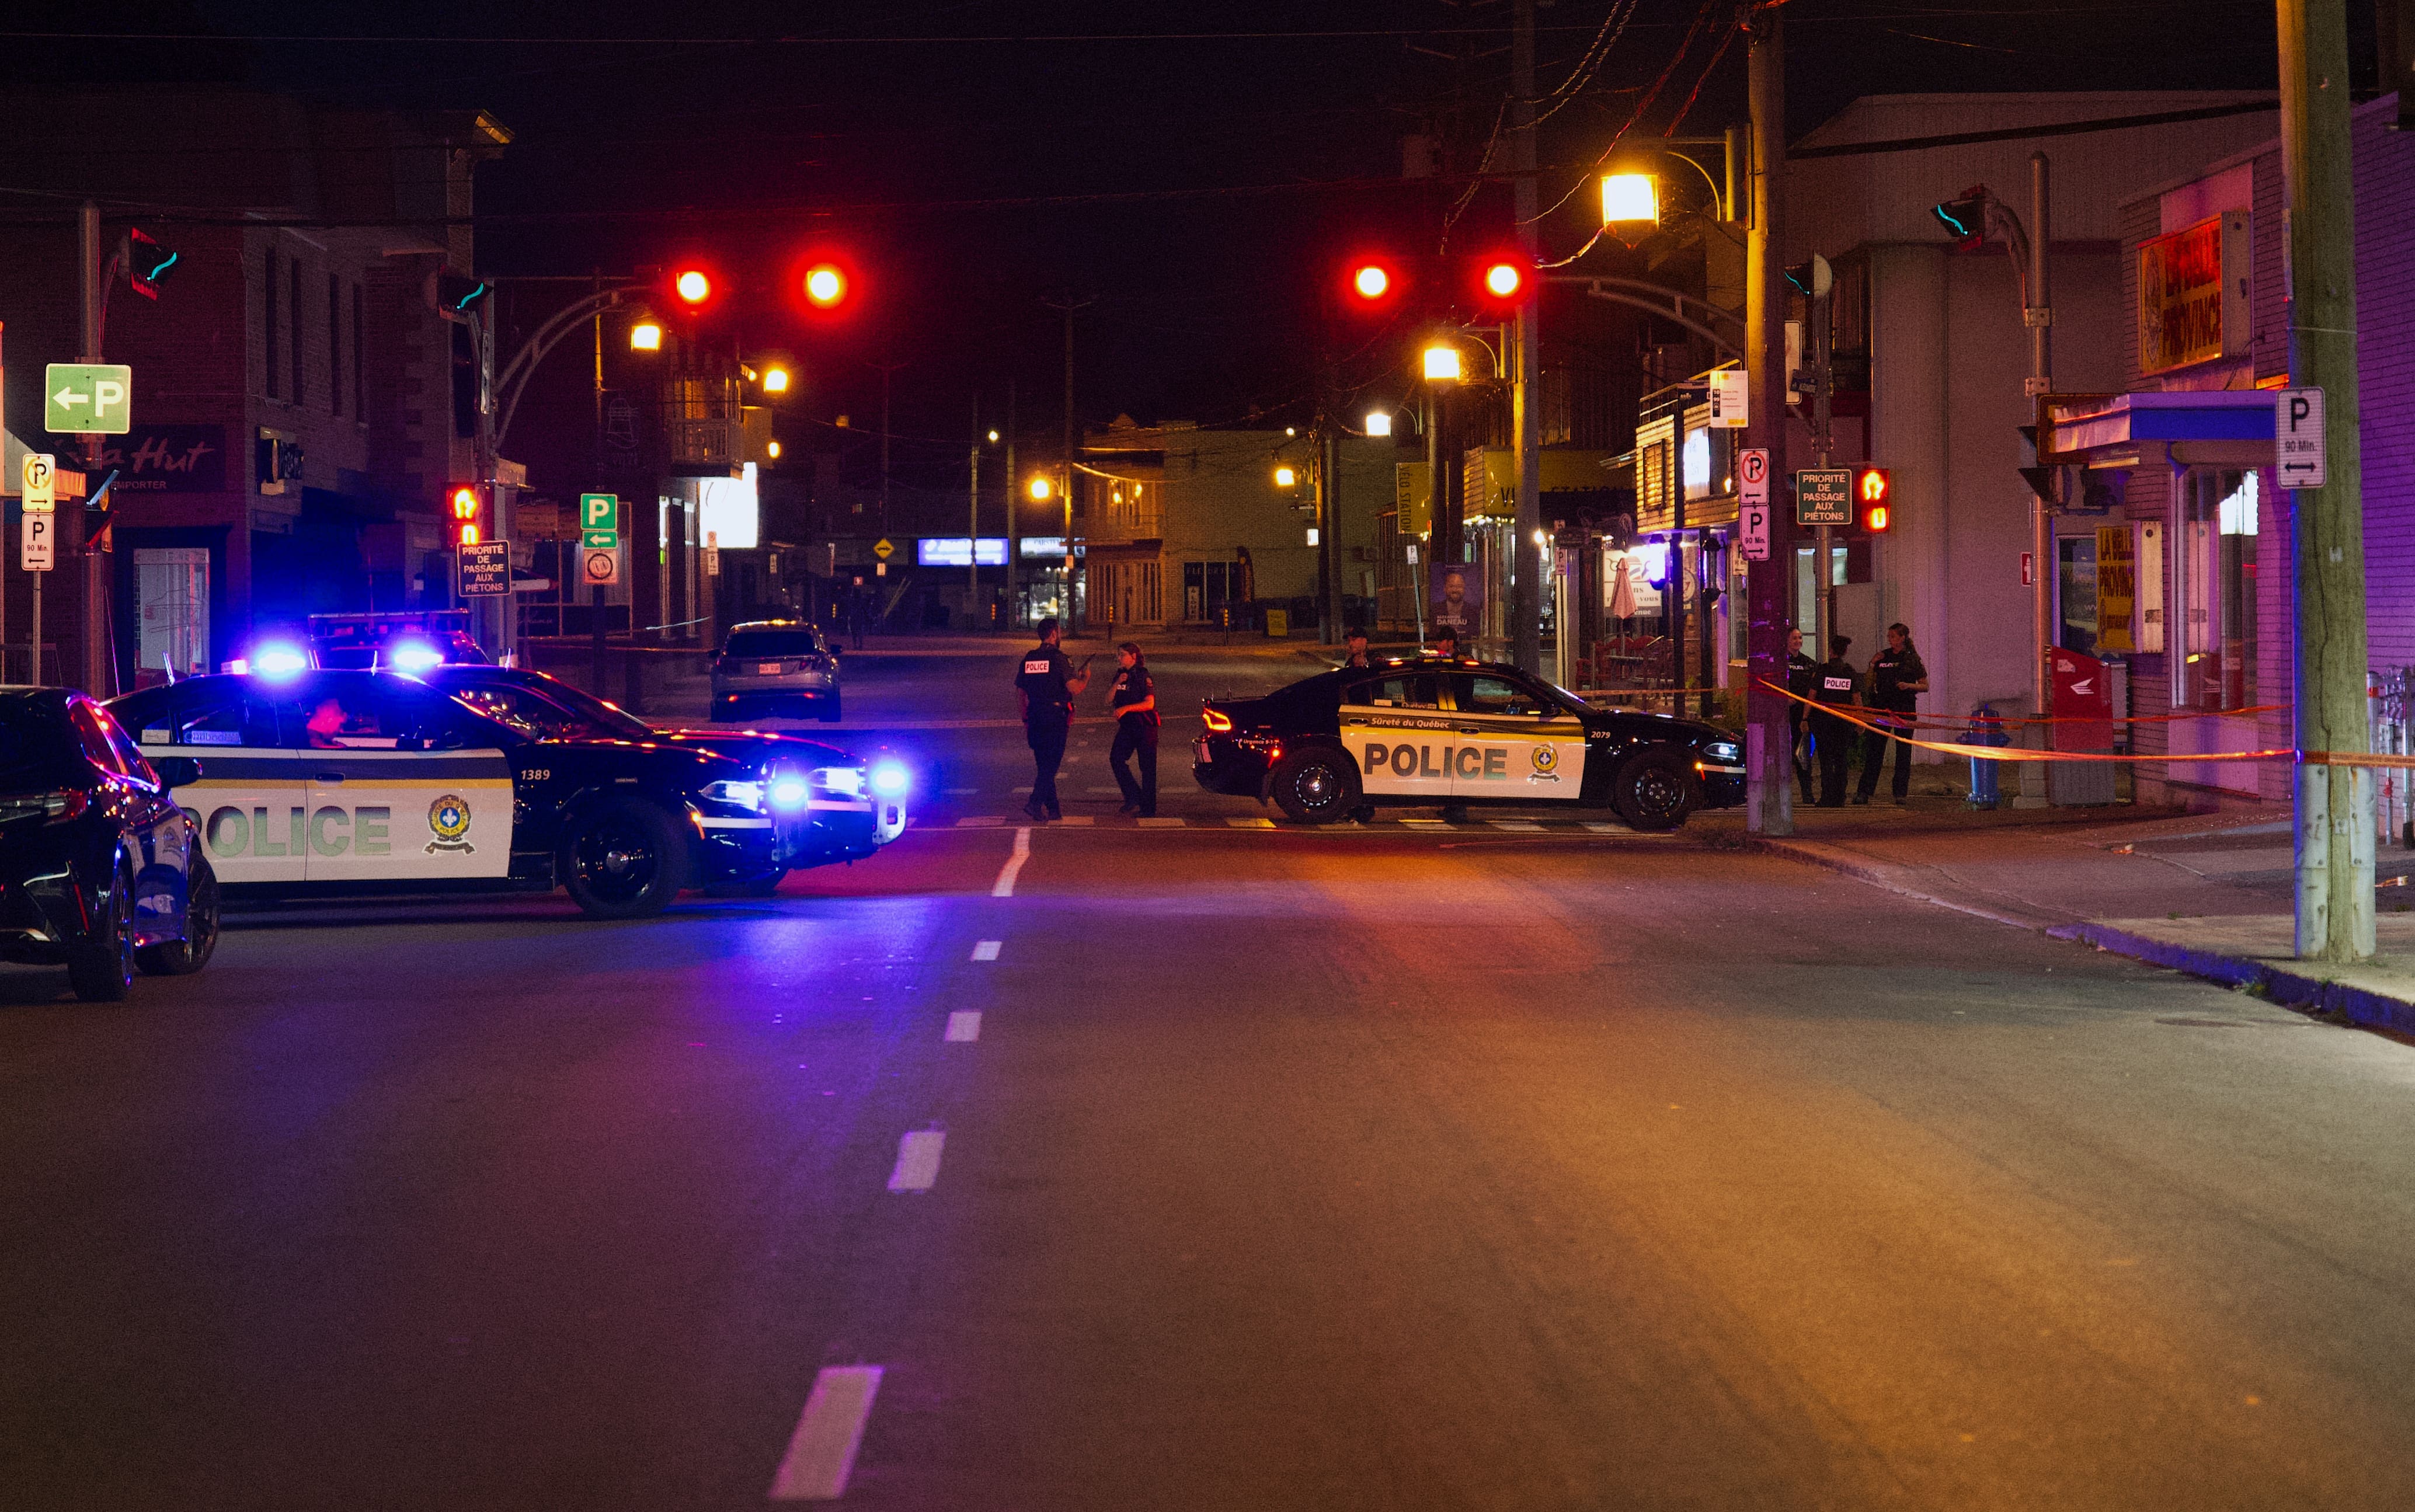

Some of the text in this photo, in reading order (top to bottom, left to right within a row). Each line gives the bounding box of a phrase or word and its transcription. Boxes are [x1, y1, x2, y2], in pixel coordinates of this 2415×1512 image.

[95, 381, 124, 417] P
[2291, 398, 2310, 432] P
[2285, 441, 2296, 452] 90
[130, 436, 215, 473] Hut
[1750, 458, 1762, 478] P
[34, 464, 46, 484] P
[1802, 473, 1846, 483] PRIORITÉ
[1817, 483, 1831, 492] DE
[1803, 493, 1846, 501] PASSAGE
[1815, 501, 1834, 510] AUX
[589, 499, 610, 525] P
[1804, 511, 1845, 520] PIÉTONS
[1751, 513, 1762, 534] P
[33, 521, 44, 541] P
[462, 544, 504, 555] PRIORITÉ
[1411, 548, 1415, 556] P
[477, 555, 490, 564] DE
[711, 555, 715, 563] P
[1559, 552, 1564, 563] P
[464, 564, 505, 573] PASSAGE
[475, 573, 494, 582] AUX
[465, 582, 504, 592] PIÉTONS
[1026, 663, 1048, 671] POLICE
[1826, 679, 1850, 688] POLICE
[1371, 717, 1401, 726] Sûreté
[1416, 720, 1450, 729] Québec
[1364, 743, 1507, 780] POLICE
[521, 769, 551, 780] 1389
